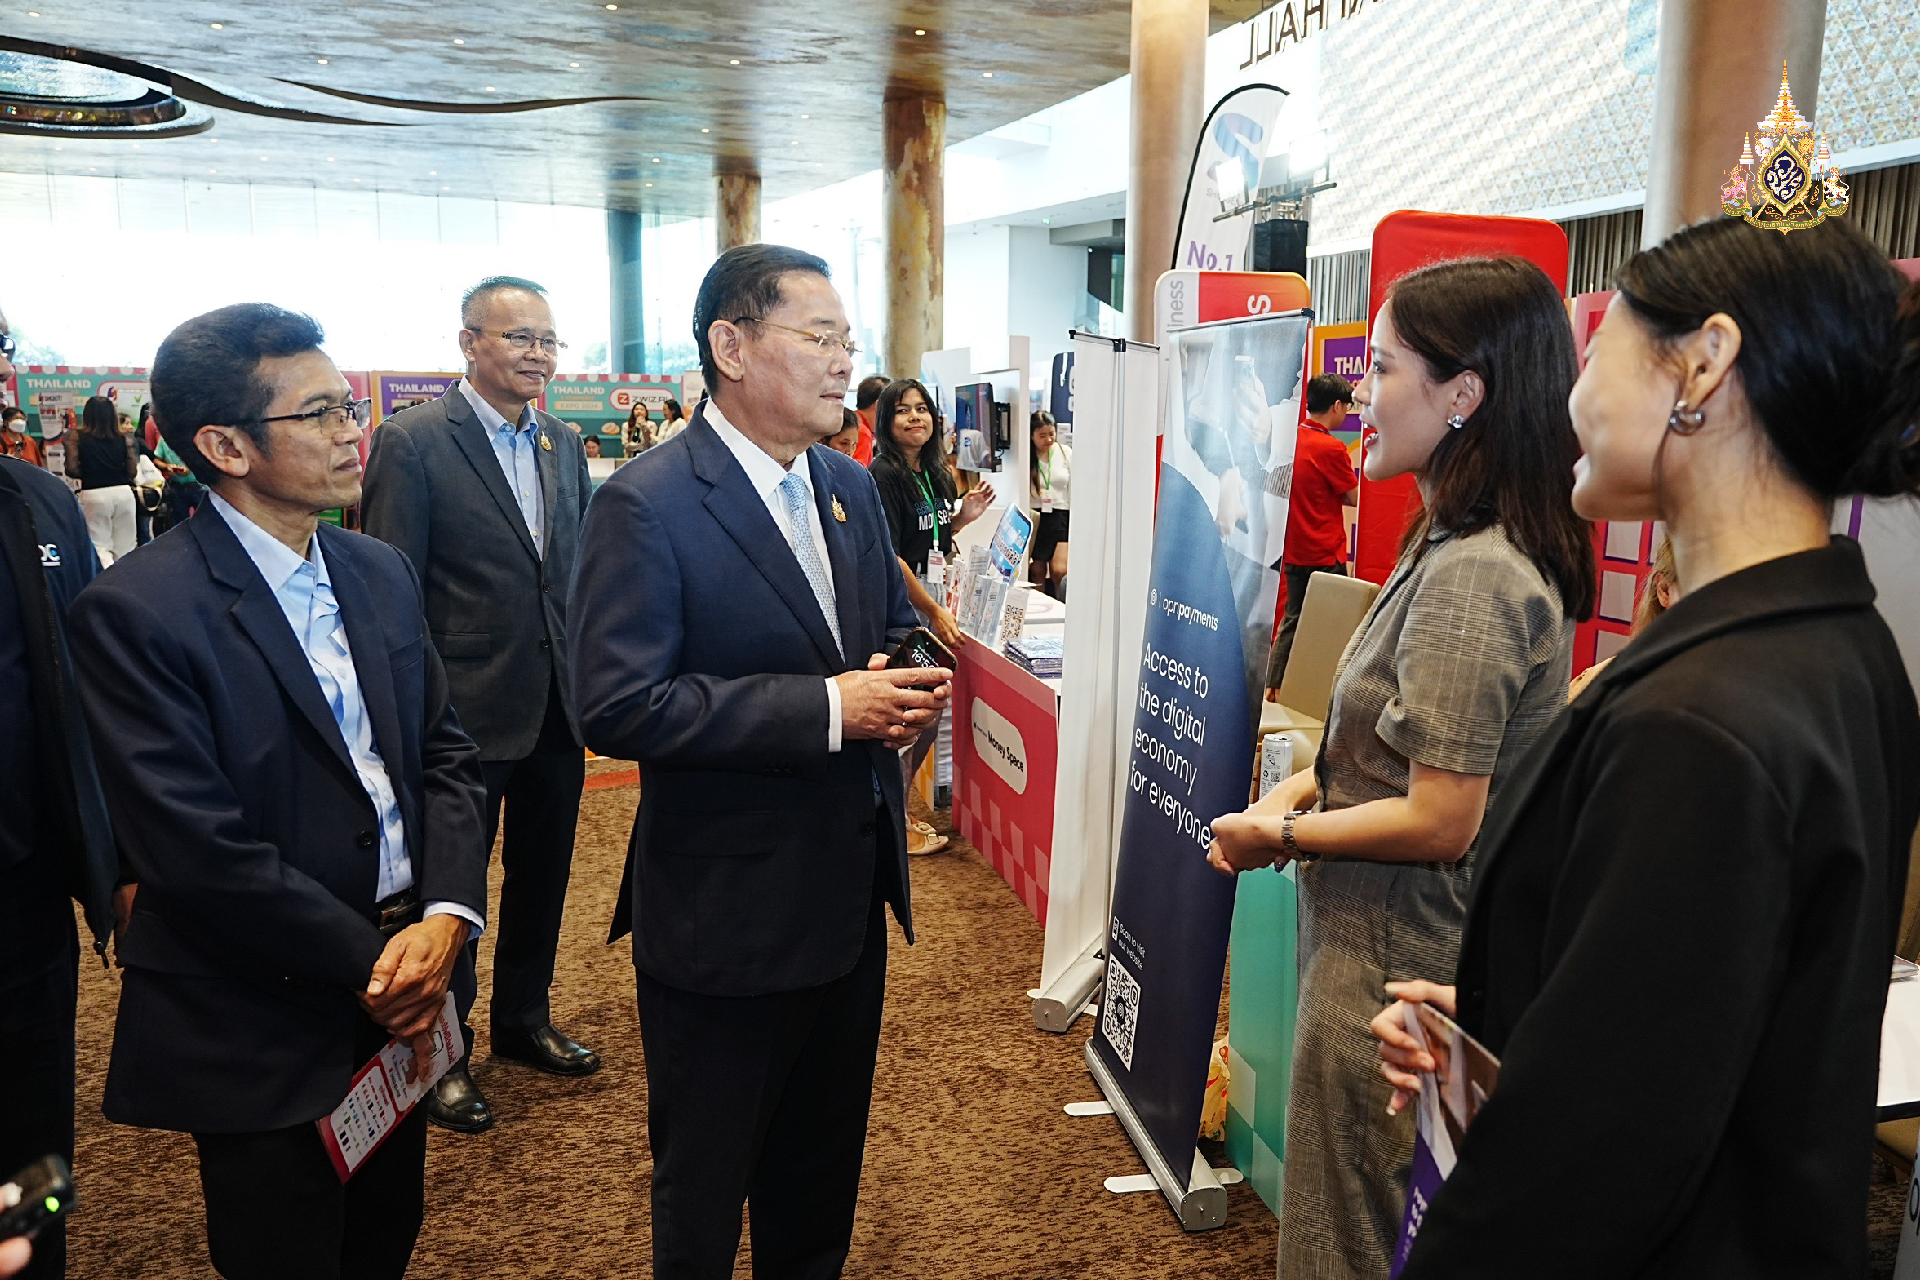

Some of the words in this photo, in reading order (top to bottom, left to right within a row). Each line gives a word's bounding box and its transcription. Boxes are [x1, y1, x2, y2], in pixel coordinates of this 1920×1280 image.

[26, 378, 92, 389] THAILAND
[388, 382, 445, 393] THAILAND
[553, 386, 605, 395] THAILAND
[1143, 643, 1191, 689] Access
[1194, 667, 1208, 698] to
[1140, 682, 1159, 716] the
[1163, 697, 1206, 746] digital
[988, 730, 1006, 759] Money
[1007, 747, 1024, 773] Space
[1135, 728, 1197, 796] economy
[1131, 760, 1147, 795] for
[1150, 782, 1210, 849] everyone
